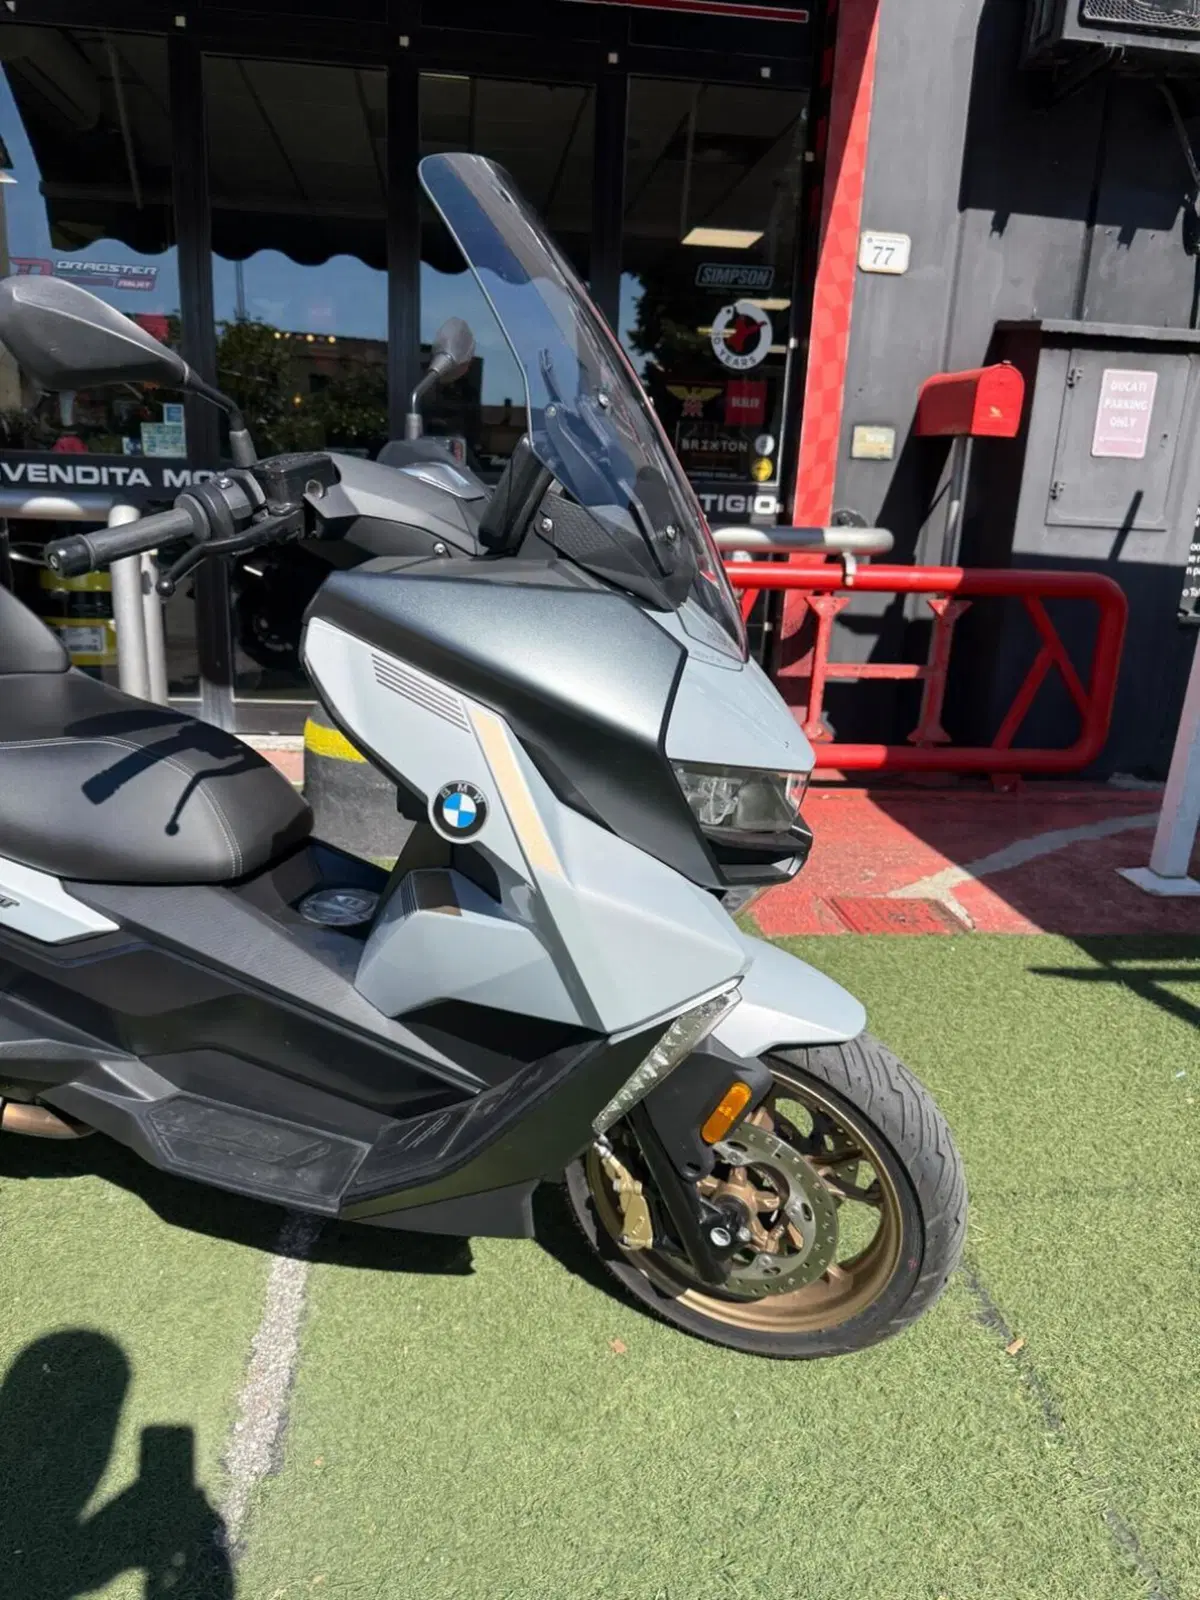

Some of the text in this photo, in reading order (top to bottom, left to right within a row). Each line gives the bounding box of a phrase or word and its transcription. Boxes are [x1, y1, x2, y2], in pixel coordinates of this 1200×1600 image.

[873, 245, 895, 265] 77
[56, 260, 157, 275] DRAGSTER
[701, 267, 769, 286] SIMPSON
[1110, 380, 1148, 393] DUCATI
[1104, 397, 1149, 411] PARKING
[1109, 416, 1137, 429] ONLY
[681, 438, 748, 453] BRIXTON
[440, 782, 485, 804] BMW
